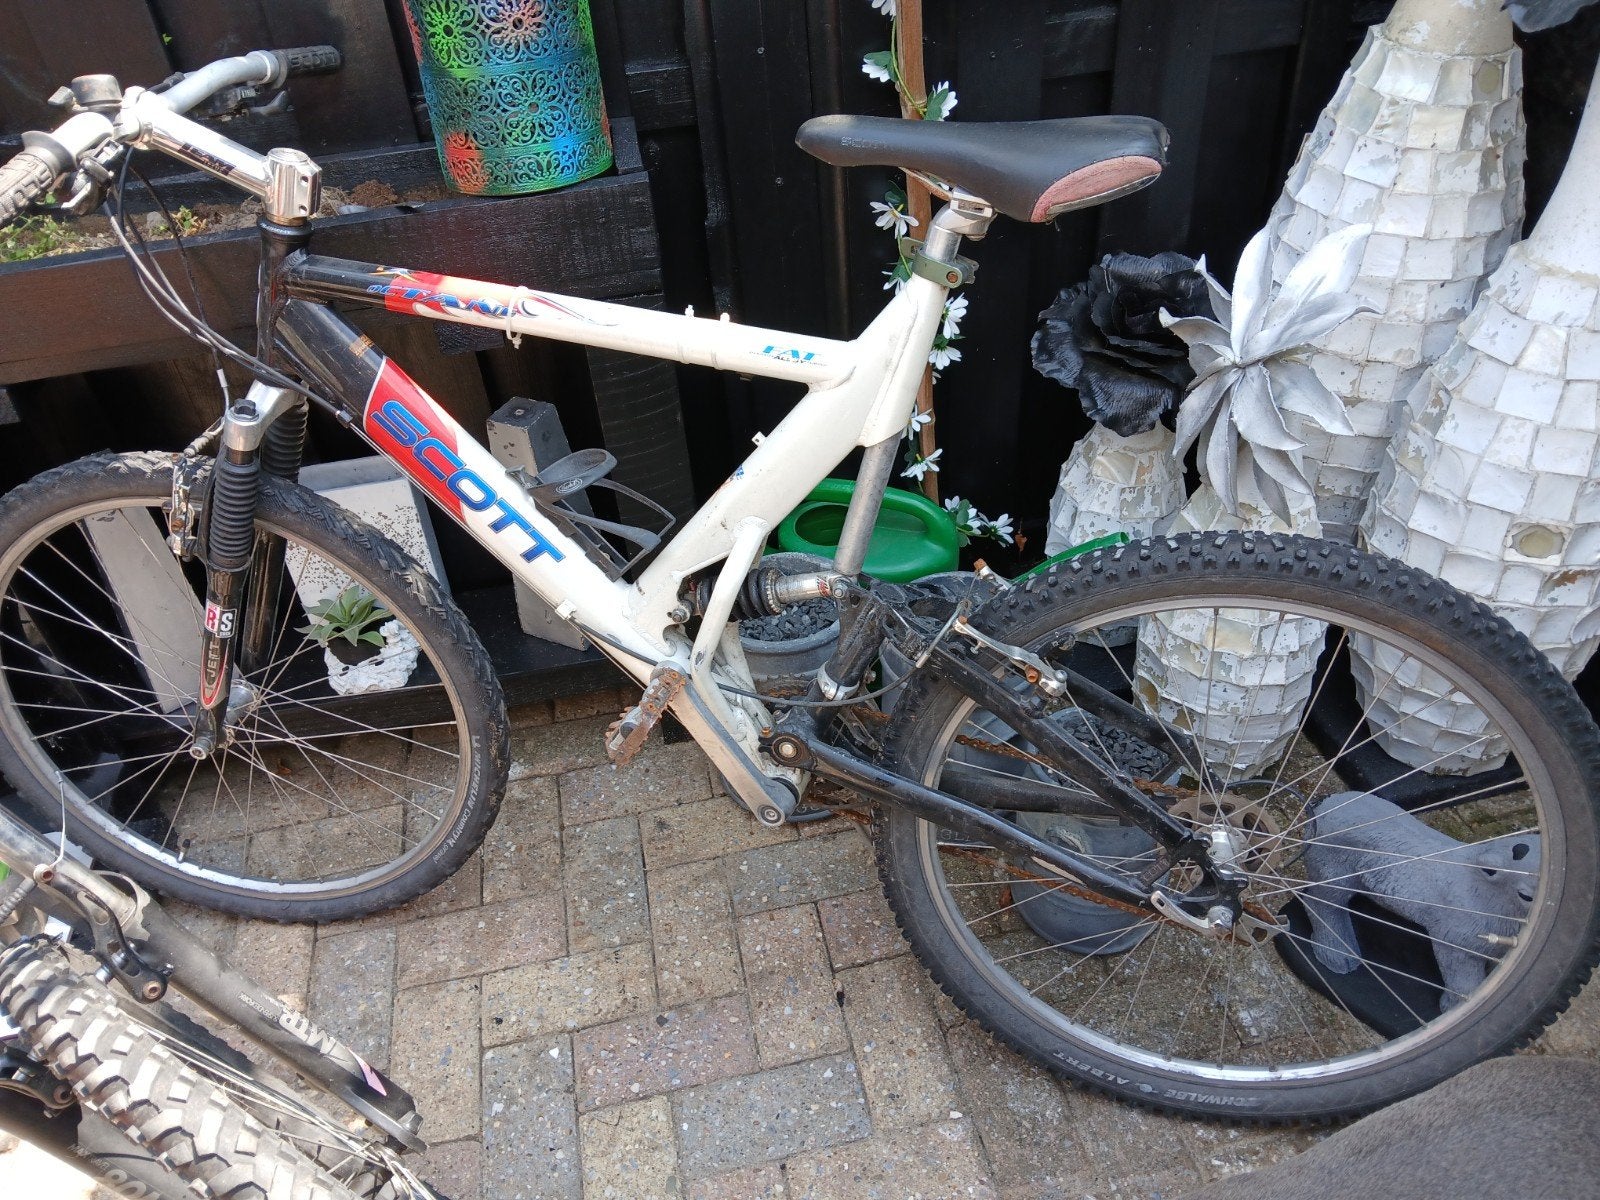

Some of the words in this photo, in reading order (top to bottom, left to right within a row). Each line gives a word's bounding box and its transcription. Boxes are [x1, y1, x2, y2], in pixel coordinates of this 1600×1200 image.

[370, 400, 566, 563] SCOTT
[467, 753, 482, 810] MICHELIN
[453, 808, 472, 841] Country
[1053, 1051, 1130, 1085] ALBERT
